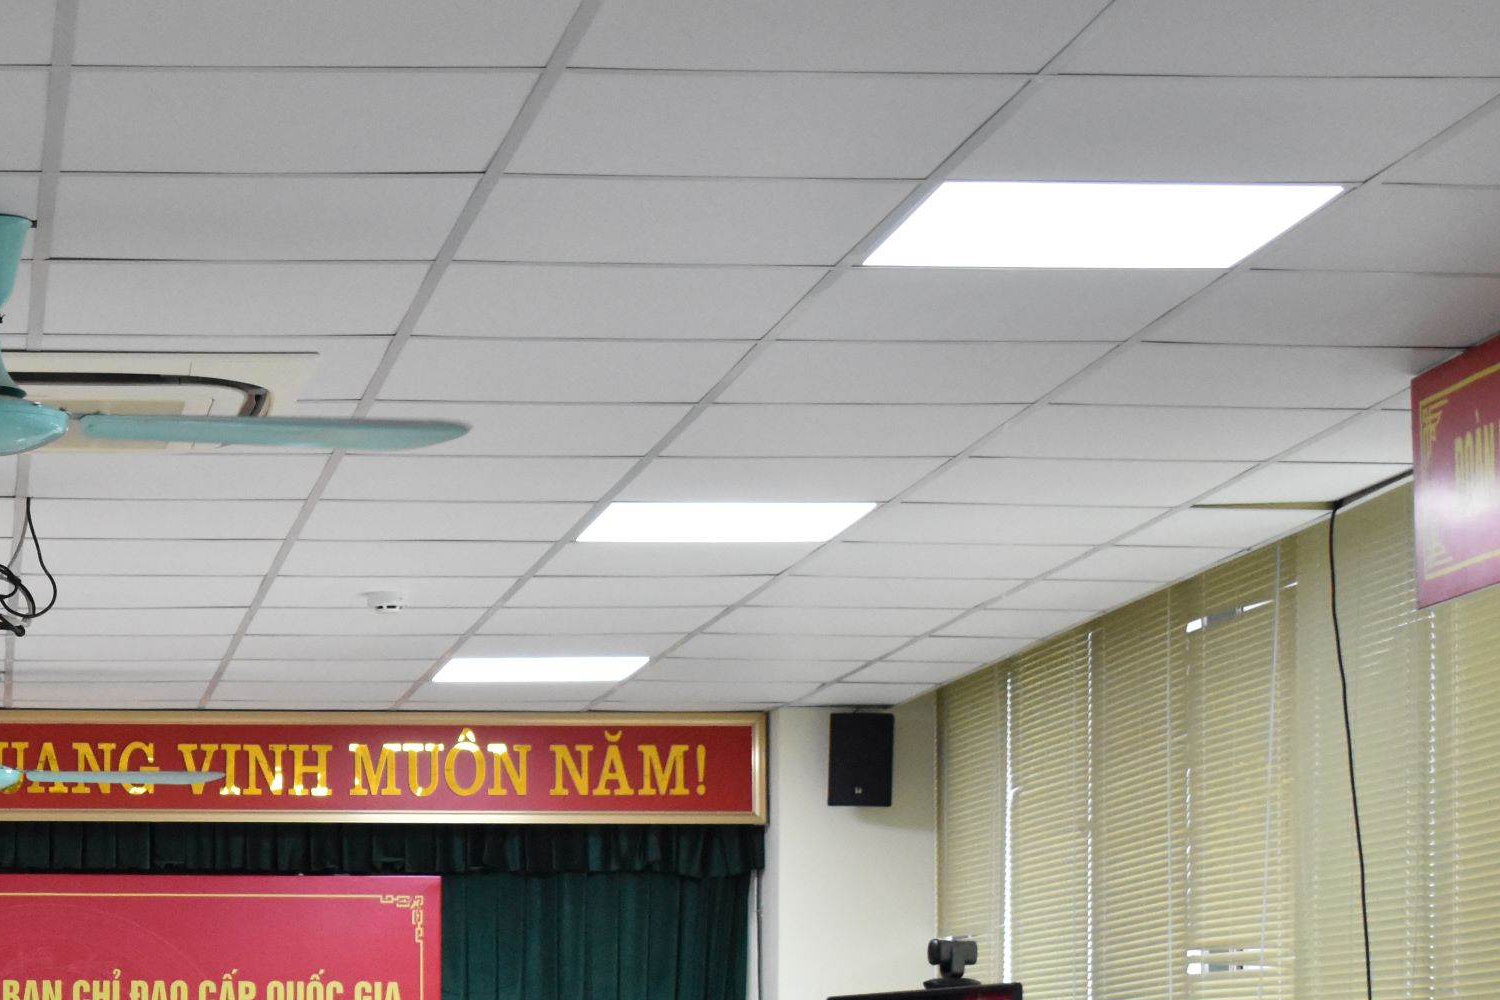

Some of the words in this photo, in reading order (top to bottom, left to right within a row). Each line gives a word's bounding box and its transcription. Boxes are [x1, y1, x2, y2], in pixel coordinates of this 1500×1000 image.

[178, 742, 334, 798] VINH
[350, 728, 531, 798] MUÔN
[549, 729, 707, 798] NĂM!
